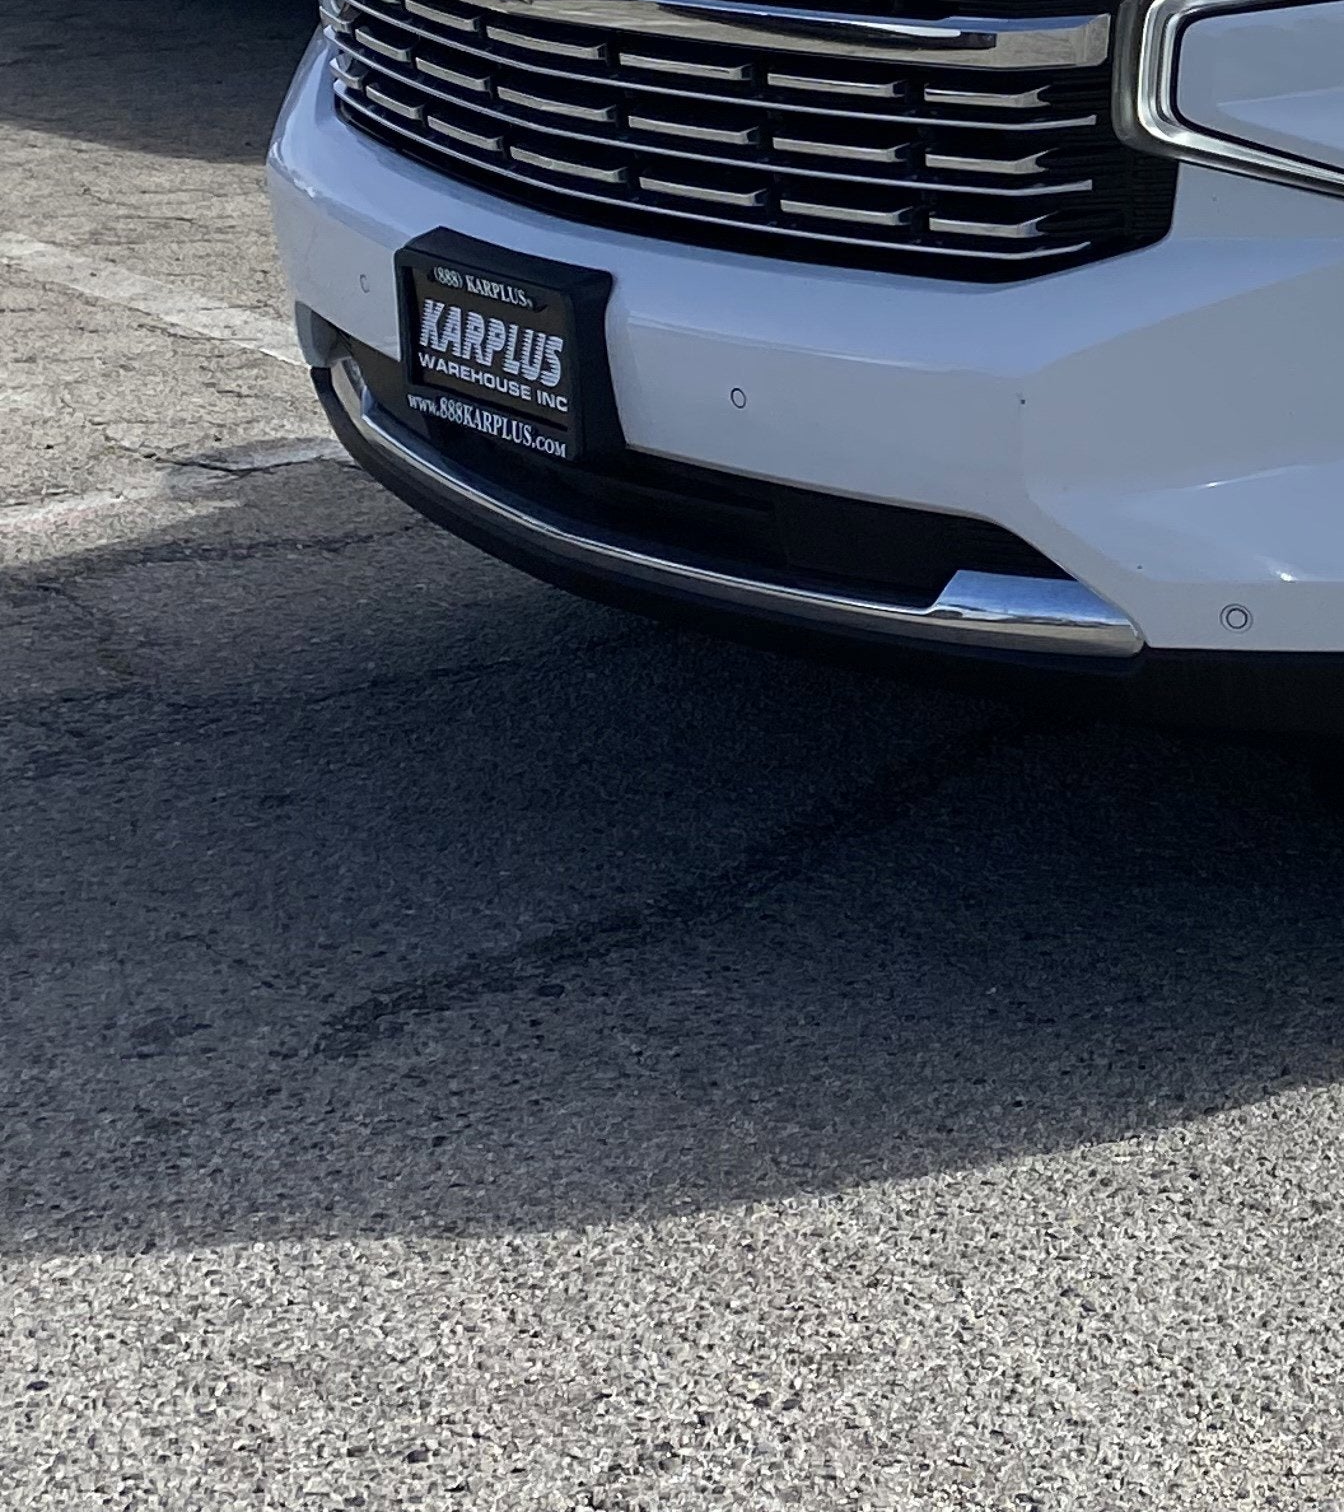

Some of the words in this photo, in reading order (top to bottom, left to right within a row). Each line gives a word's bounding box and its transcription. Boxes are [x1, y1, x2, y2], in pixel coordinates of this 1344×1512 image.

[433, 266, 463, 289] (888)
[419, 298, 564, 388] KARPLUS
[418, 351, 532, 401] WAREHOUSE
[536, 390, 569, 412] INC
